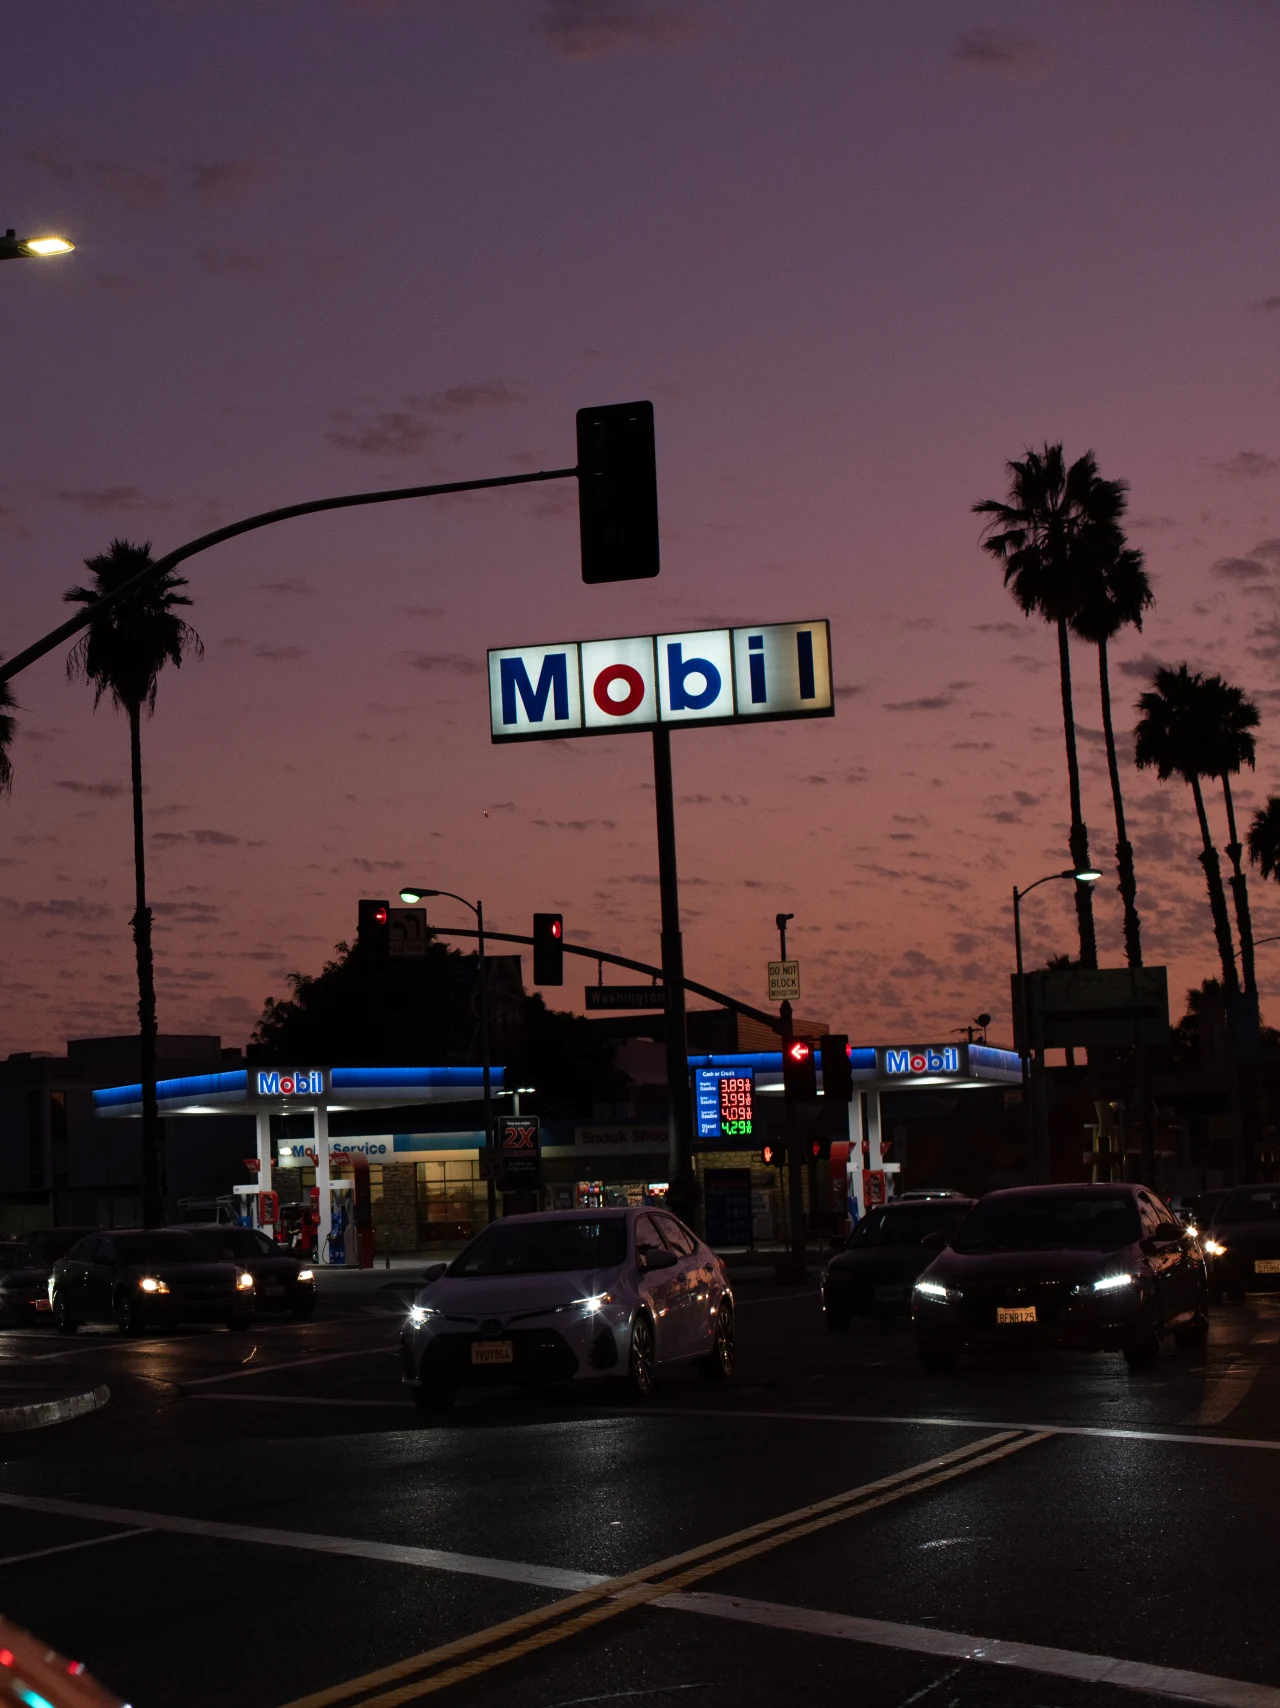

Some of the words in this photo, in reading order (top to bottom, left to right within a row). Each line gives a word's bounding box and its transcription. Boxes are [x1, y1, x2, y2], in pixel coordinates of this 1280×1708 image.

[499, 630, 817, 725] Mobil
[769, 967, 780, 976] DO
[782, 966, 797, 975] NOT
[771, 978, 797, 988] BLOCK
[591, 990, 665, 1006] Washington
[886, 1047, 959, 1074] Mobil
[258, 1071, 323, 1095] Mobil
[721, 1079, 744, 1092] 3.89
[721, 1093, 745, 1106] 3.99
[721, 1107, 746, 1121] 4.09
[721, 1120, 746, 1135] 4.29
[503, 1126, 536, 1149] 2X
[582, 1130, 627, 1144] Snack
[632, 1129, 669, 1145] Shop
[333, 1142, 387, 1155] Service
